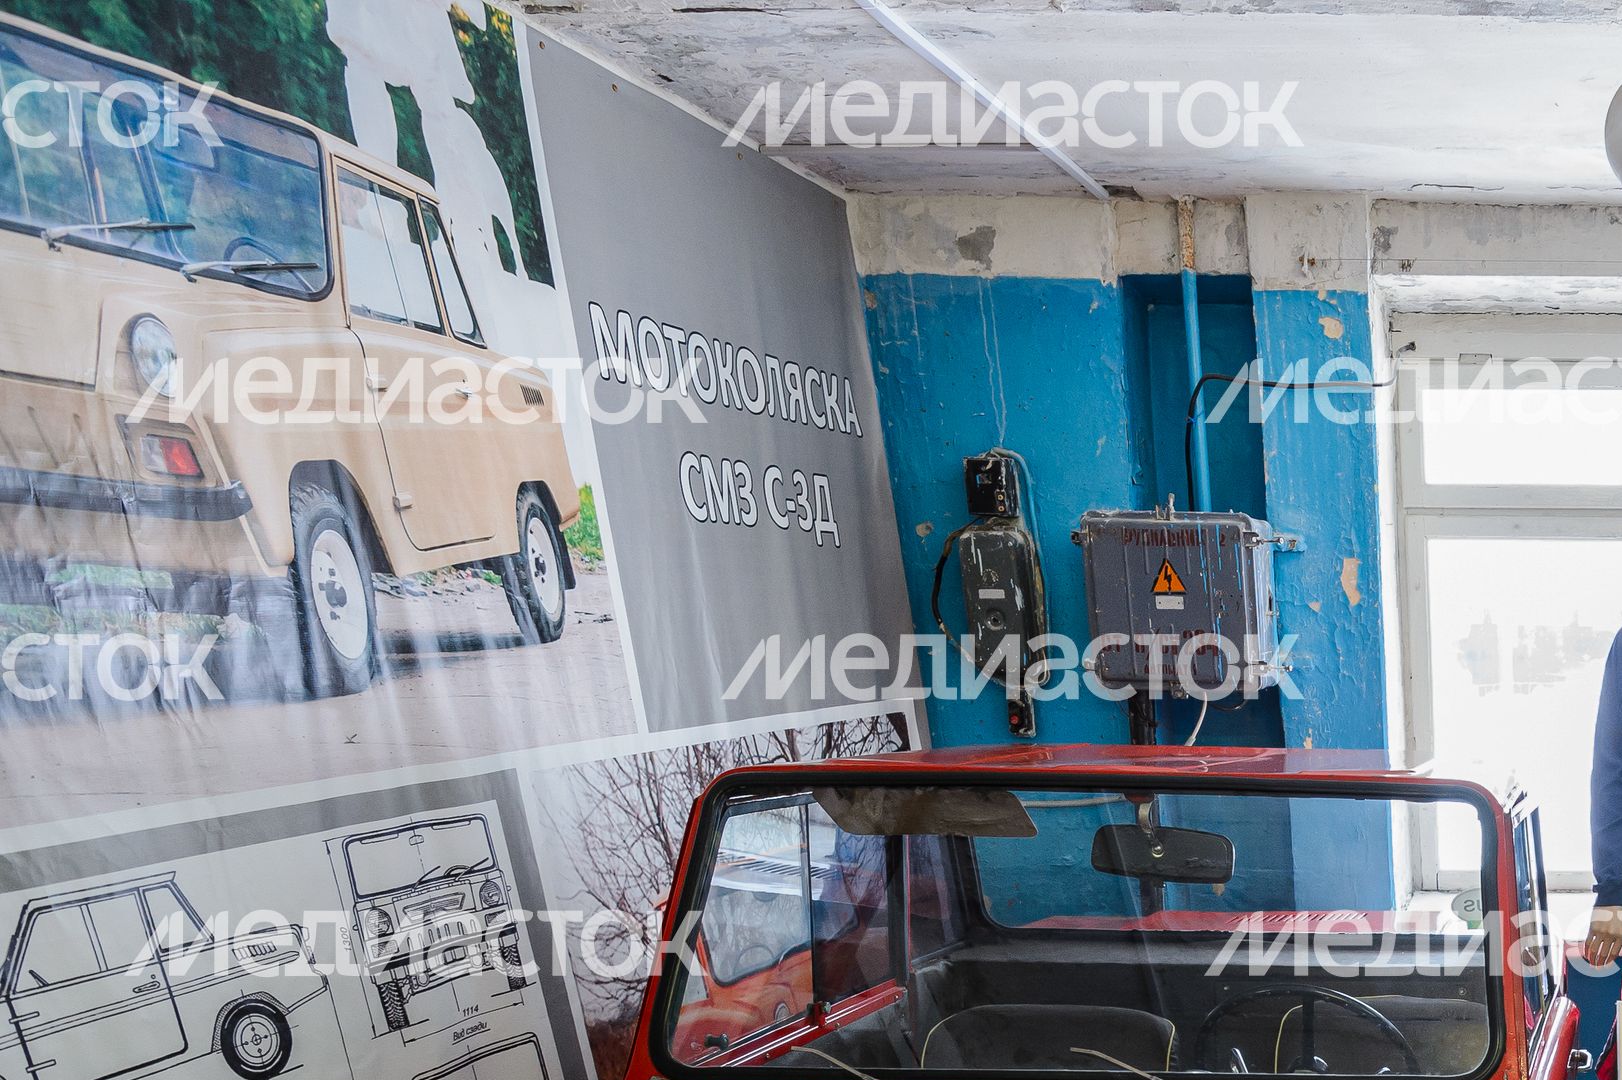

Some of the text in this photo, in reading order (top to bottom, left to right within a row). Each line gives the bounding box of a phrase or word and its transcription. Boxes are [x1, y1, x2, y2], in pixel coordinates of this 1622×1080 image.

[588, 301, 863, 437] МОТОКОЛЯСКА
[339, 927, 352, 951] 1300
[462, 1004, 479, 1017] 1114
